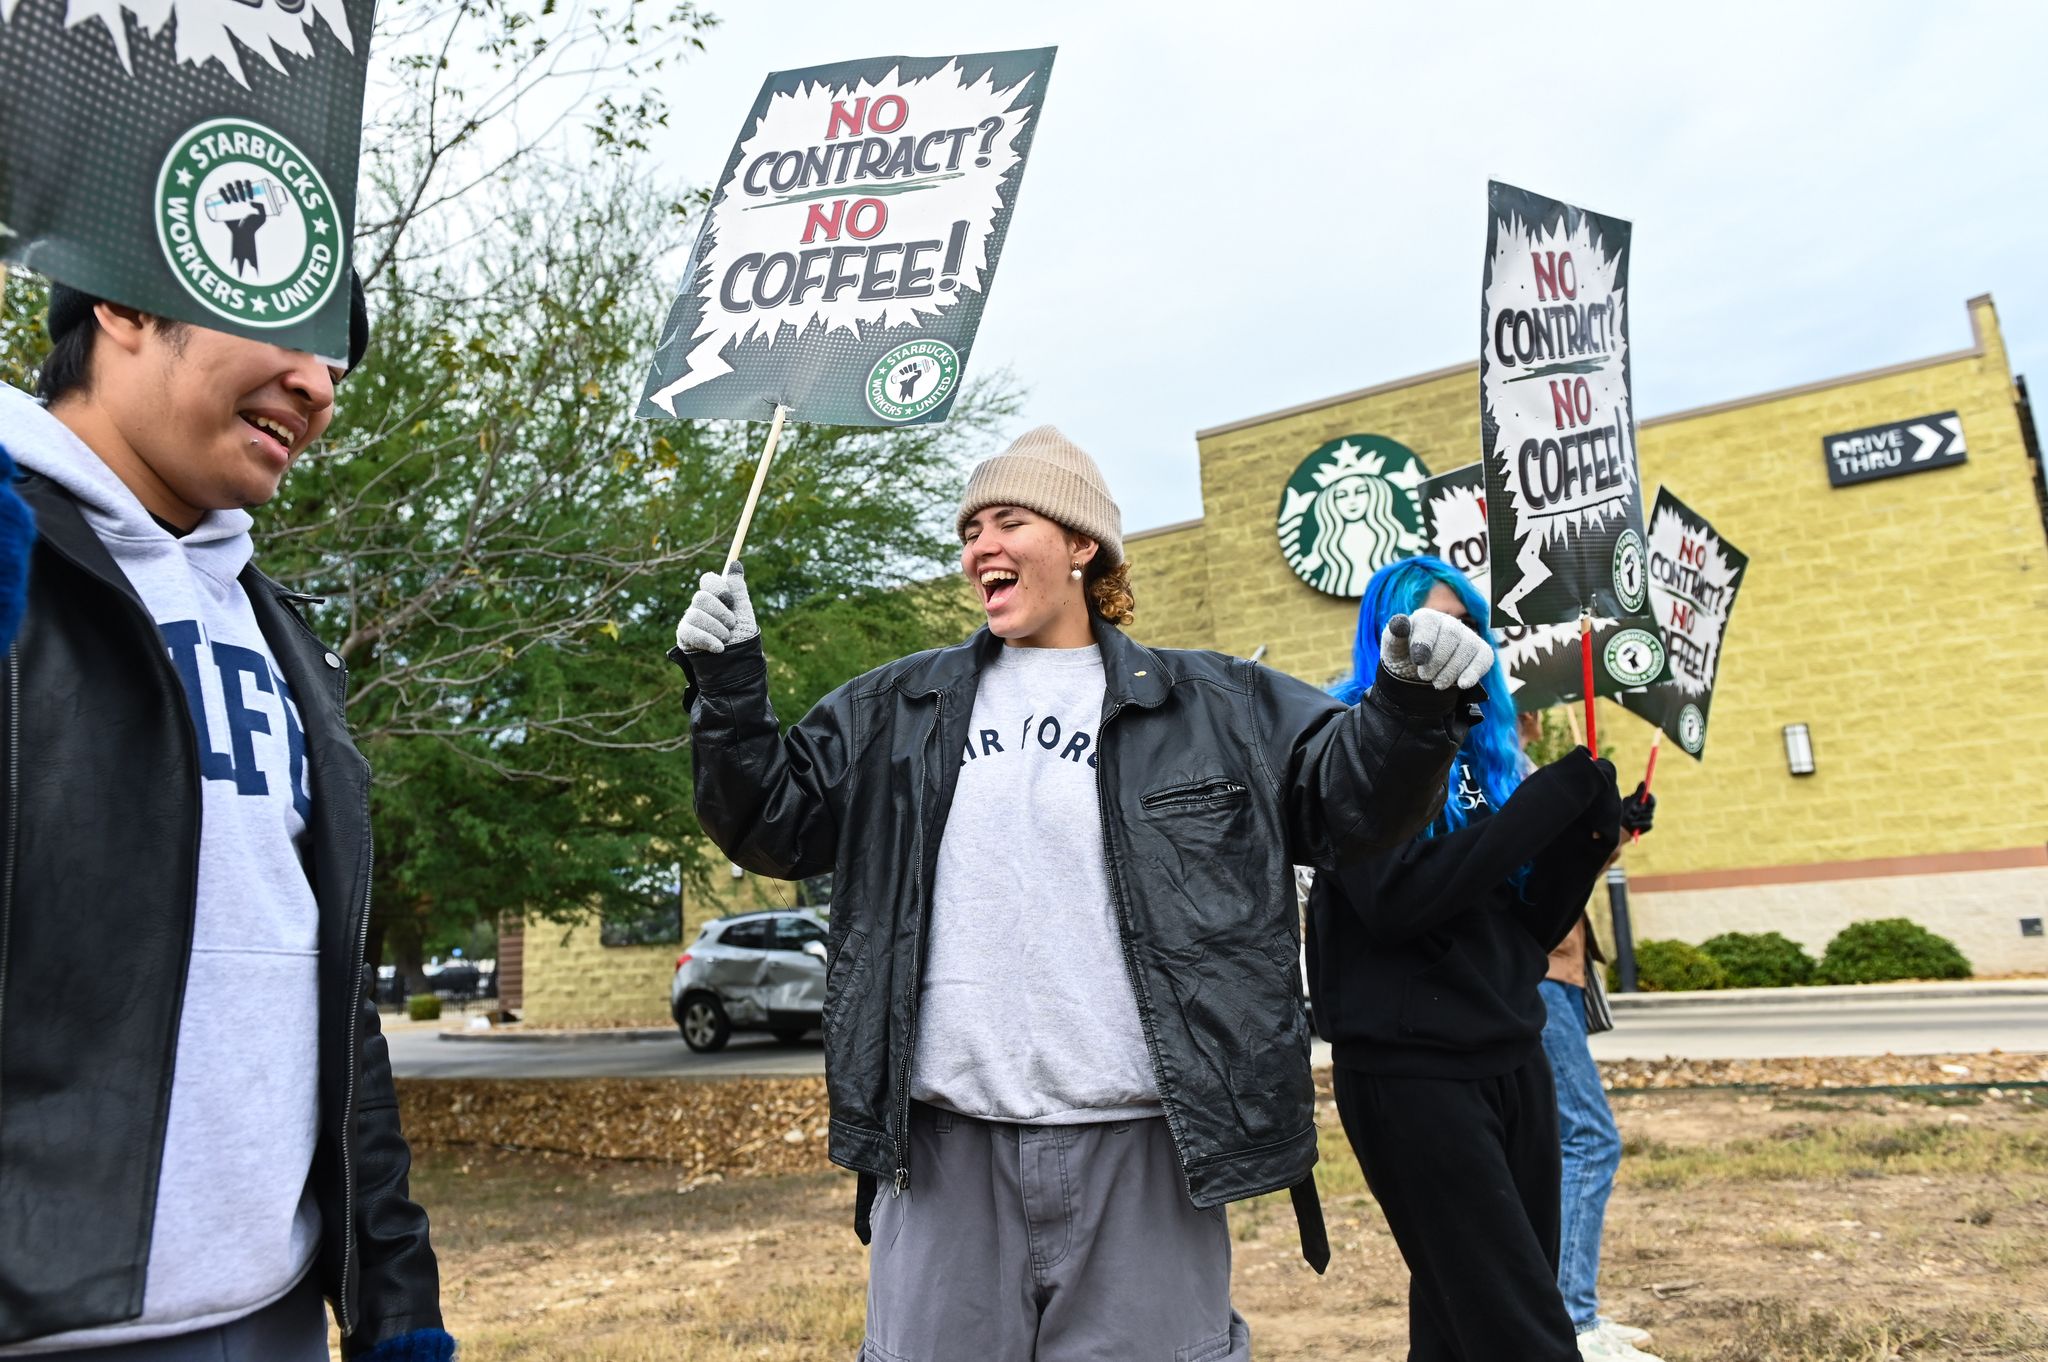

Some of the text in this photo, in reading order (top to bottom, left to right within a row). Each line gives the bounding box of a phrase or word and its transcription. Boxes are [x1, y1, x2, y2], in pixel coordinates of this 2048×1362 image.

[824, 94, 909, 140] NO
[189, 131, 323, 210] STARBUCKS
[743, 115, 1005, 196] CONTRACT?
[800, 197, 888, 244] NO
[167, 197, 245, 310] WORKERS
[270, 243, 332, 313] UNITED
[719, 219, 971, 314] COFFEE!
[1531, 251, 1577, 302] NO
[886, 344, 952, 366] STARBUCKS
[1495, 294, 1616, 367] CONTRACT?
[872, 378, 903, 416] WORKERS
[915, 376, 951, 412] UNITED
[1549, 376, 1591, 430] NO
[1518, 405, 1629, 510] COFFEE!
[1831, 429, 1904, 458] DRIVE
[1835, 448, 1902, 476] THRU
[1679, 535, 1706, 570] NO
[1651, 552, 1724, 615] CONTRACT?
[1670, 600, 1695, 635] NO
[961, 729, 1005, 767] IR
